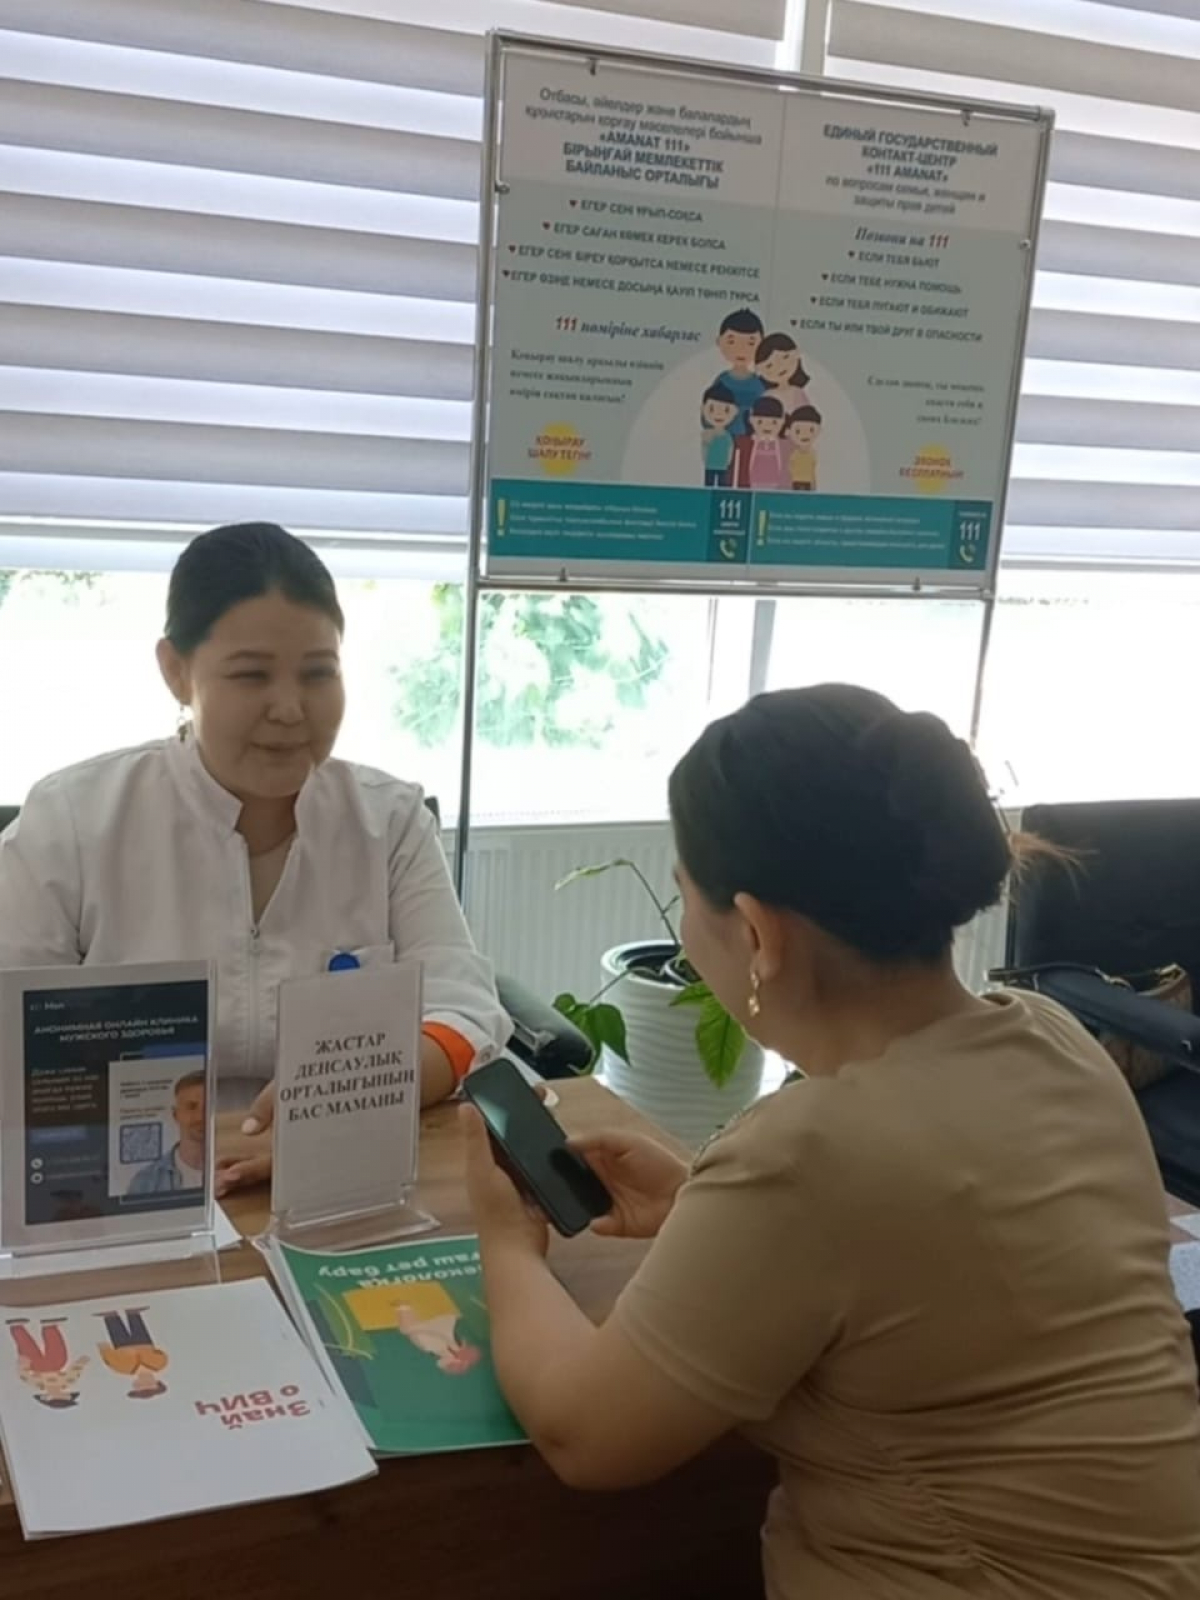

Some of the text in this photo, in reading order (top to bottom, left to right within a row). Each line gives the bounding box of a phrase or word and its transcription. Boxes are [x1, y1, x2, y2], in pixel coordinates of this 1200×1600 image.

[823, 123, 998, 157] ЕДИНЫЙ ГОСУДАРСТВЕННЫЙ
[635, 152, 724, 173] МЕМЛЕКЕТТІК
[862, 146, 956, 167] КОНТАКТ-ЦЕНТР
[566, 158, 642, 181] БАЙЛАНЫС
[581, 200, 607, 212] ЕГЕР
[554, 222, 580, 235] ЕГЕР
[929, 235, 949, 249] 111
[518, 244, 545, 257] ЕГЕР
[666, 259, 709, 274] НЕМЕСЕ
[859, 251, 940, 269] ЕСЛИ ТЕБЯ БЬЮТ
[511, 269, 537, 282] ЕГЕР
[573, 276, 615, 290] НЕМЕСЕ
[831, 273, 962, 295] ЕСЛИ ТЕБЕ НУЖНА ПОМОЩЬ
[820, 296, 845, 307] ЕСЛИ
[847, 298, 871, 309] ТЕБЯ
[872, 300, 910, 313] ПУГАЮТ
[920, 305, 970, 318] ОБИЖАЮТ
[555, 316, 579, 331] 111
[801, 319, 983, 343] ЕСЛИ ТЫ ИЛИ ТВОЙ ДРУГ В ОПАСНОСТИ
[719, 499, 742, 519] 111
[959, 521, 981, 541] 111
[315, 1032, 386, 1055] ЖАСТАР
[289, 1090, 405, 1121] БАС МАМАНЫ
[318, 1265, 380, 1278] бару
[194, 1384, 300, 1416] о ВИЧ
[220, 1400, 311, 1430] Знай
